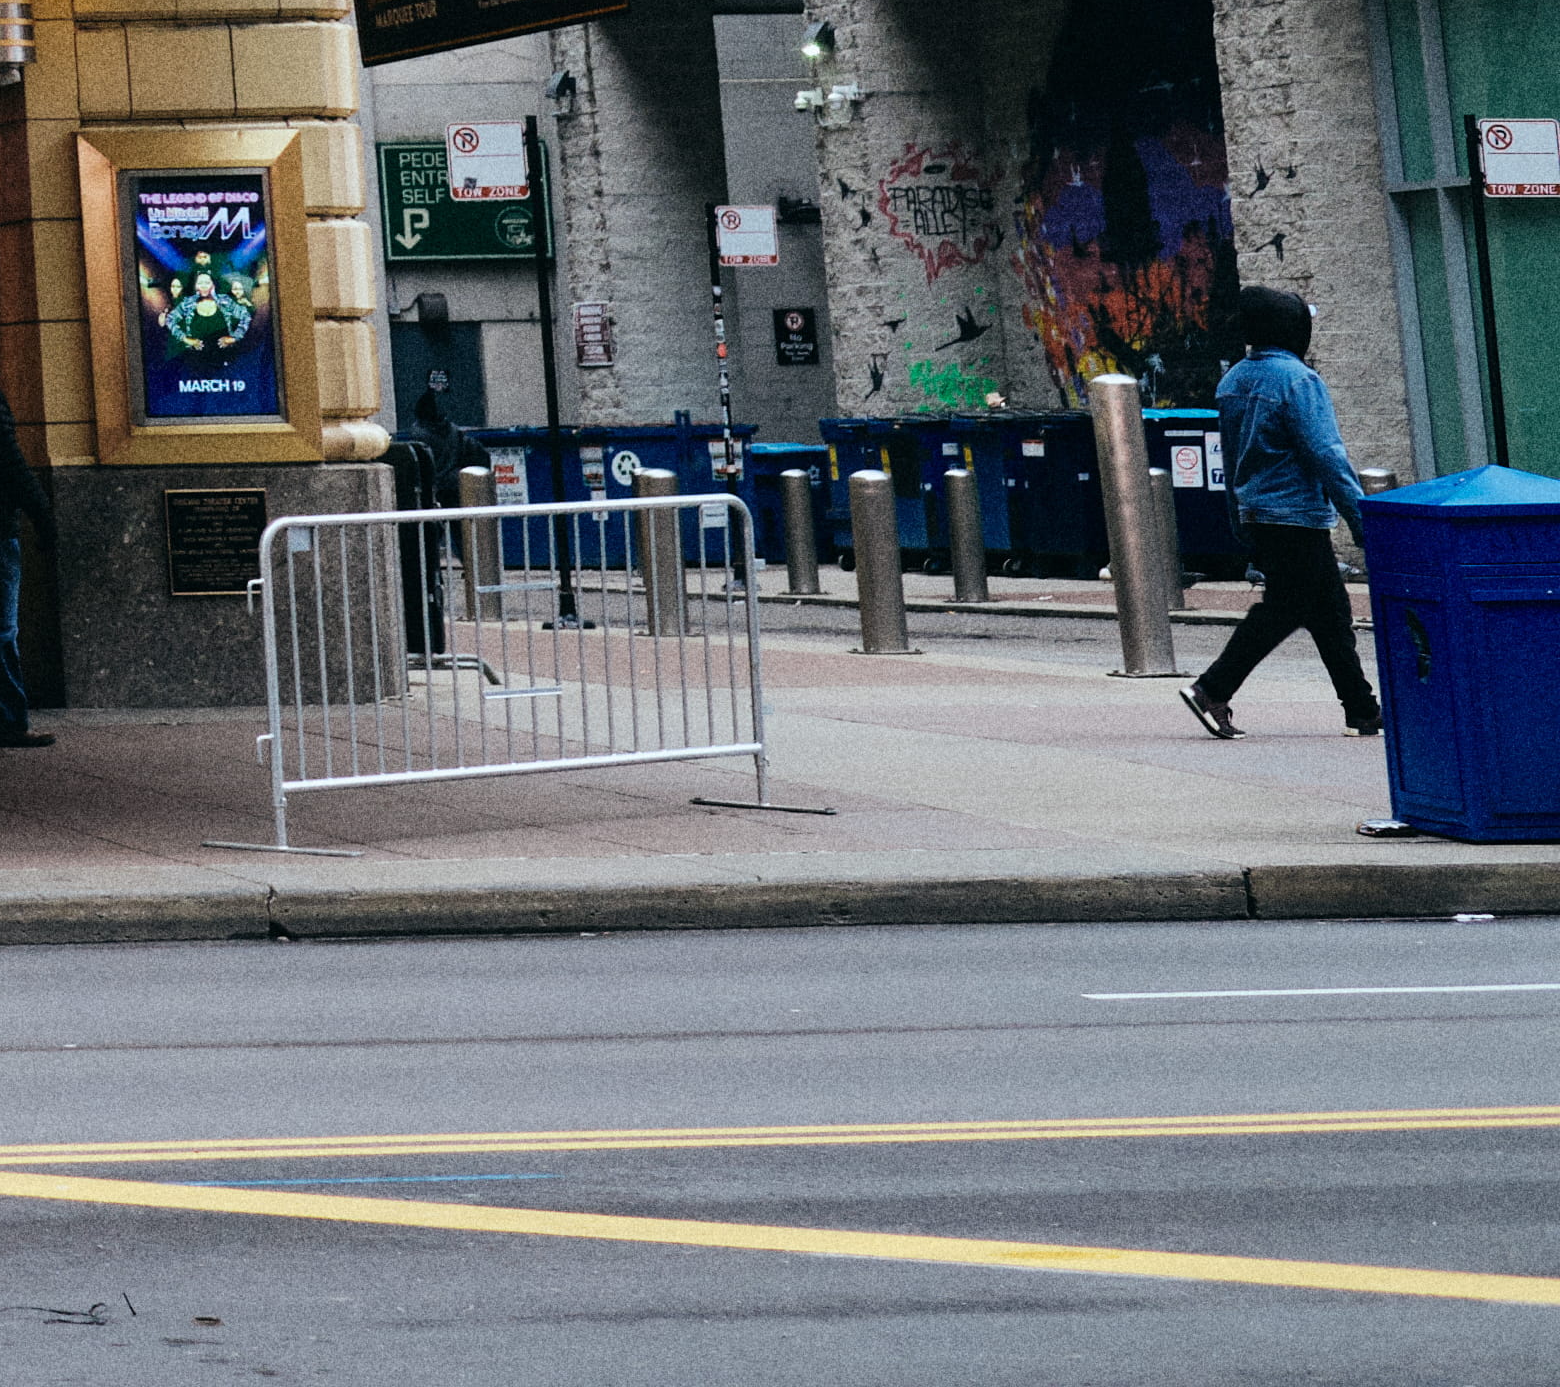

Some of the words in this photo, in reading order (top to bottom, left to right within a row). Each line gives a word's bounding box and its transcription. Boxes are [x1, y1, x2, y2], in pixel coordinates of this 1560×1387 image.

[458, 188, 482, 198] TOW
[490, 187, 522, 198] ZONE
[1491, 184, 1517, 195] TOW
[1523, 184, 1558, 195] ZONE
[139, 194, 162, 204] THE
[225, 192, 259, 203] DISCO
[402, 188, 445, 204] SELF
[179, 380, 230, 393] MARCH
[232, 380, 246, 392] 19
